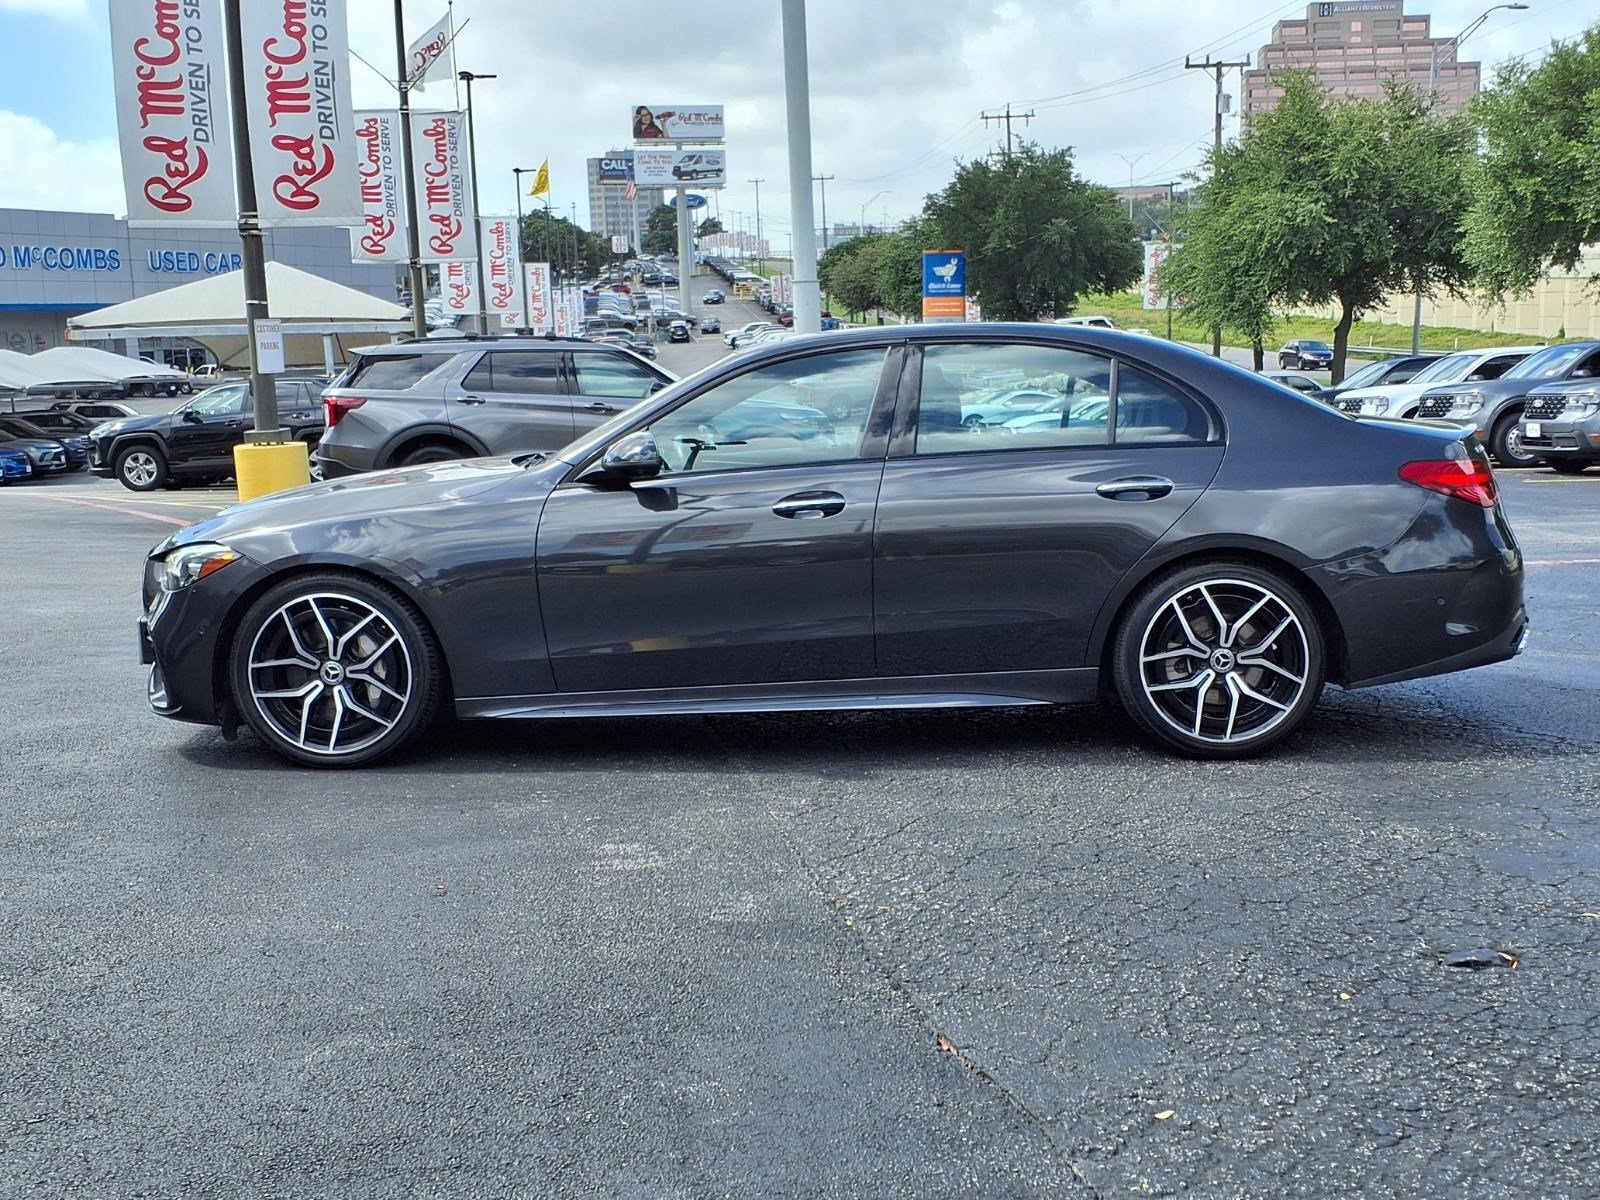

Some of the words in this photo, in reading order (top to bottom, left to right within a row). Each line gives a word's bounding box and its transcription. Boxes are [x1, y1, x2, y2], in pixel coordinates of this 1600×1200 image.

[185, 26, 203, 55] TO
[311, 24, 328, 53] TO
[187, 62, 210, 143] DRIVEN
[313, 60, 335, 140] DRIVEN
[380, 117, 391, 153] SERVE
[447, 117, 458, 153] SERVE
[143, 135, 208, 212] Red
[271, 134, 334, 210] Red
[382, 156, 392, 172] TO
[423, 118, 450, 210] McCombs
[449, 155, 460, 171] TO
[384, 174, 396, 217] DRIVEN
[451, 174, 463, 217] DRIVEN
[361, 214, 395, 254] Red
[429, 213, 462, 254] Red
[489, 221, 506, 280] McCombs
[150, 251, 200, 271] USED
[205, 253, 242, 272] CAR
[449, 283, 470, 309] Red
[491, 282, 513, 308] Red
[532, 307, 547, 324] Red
